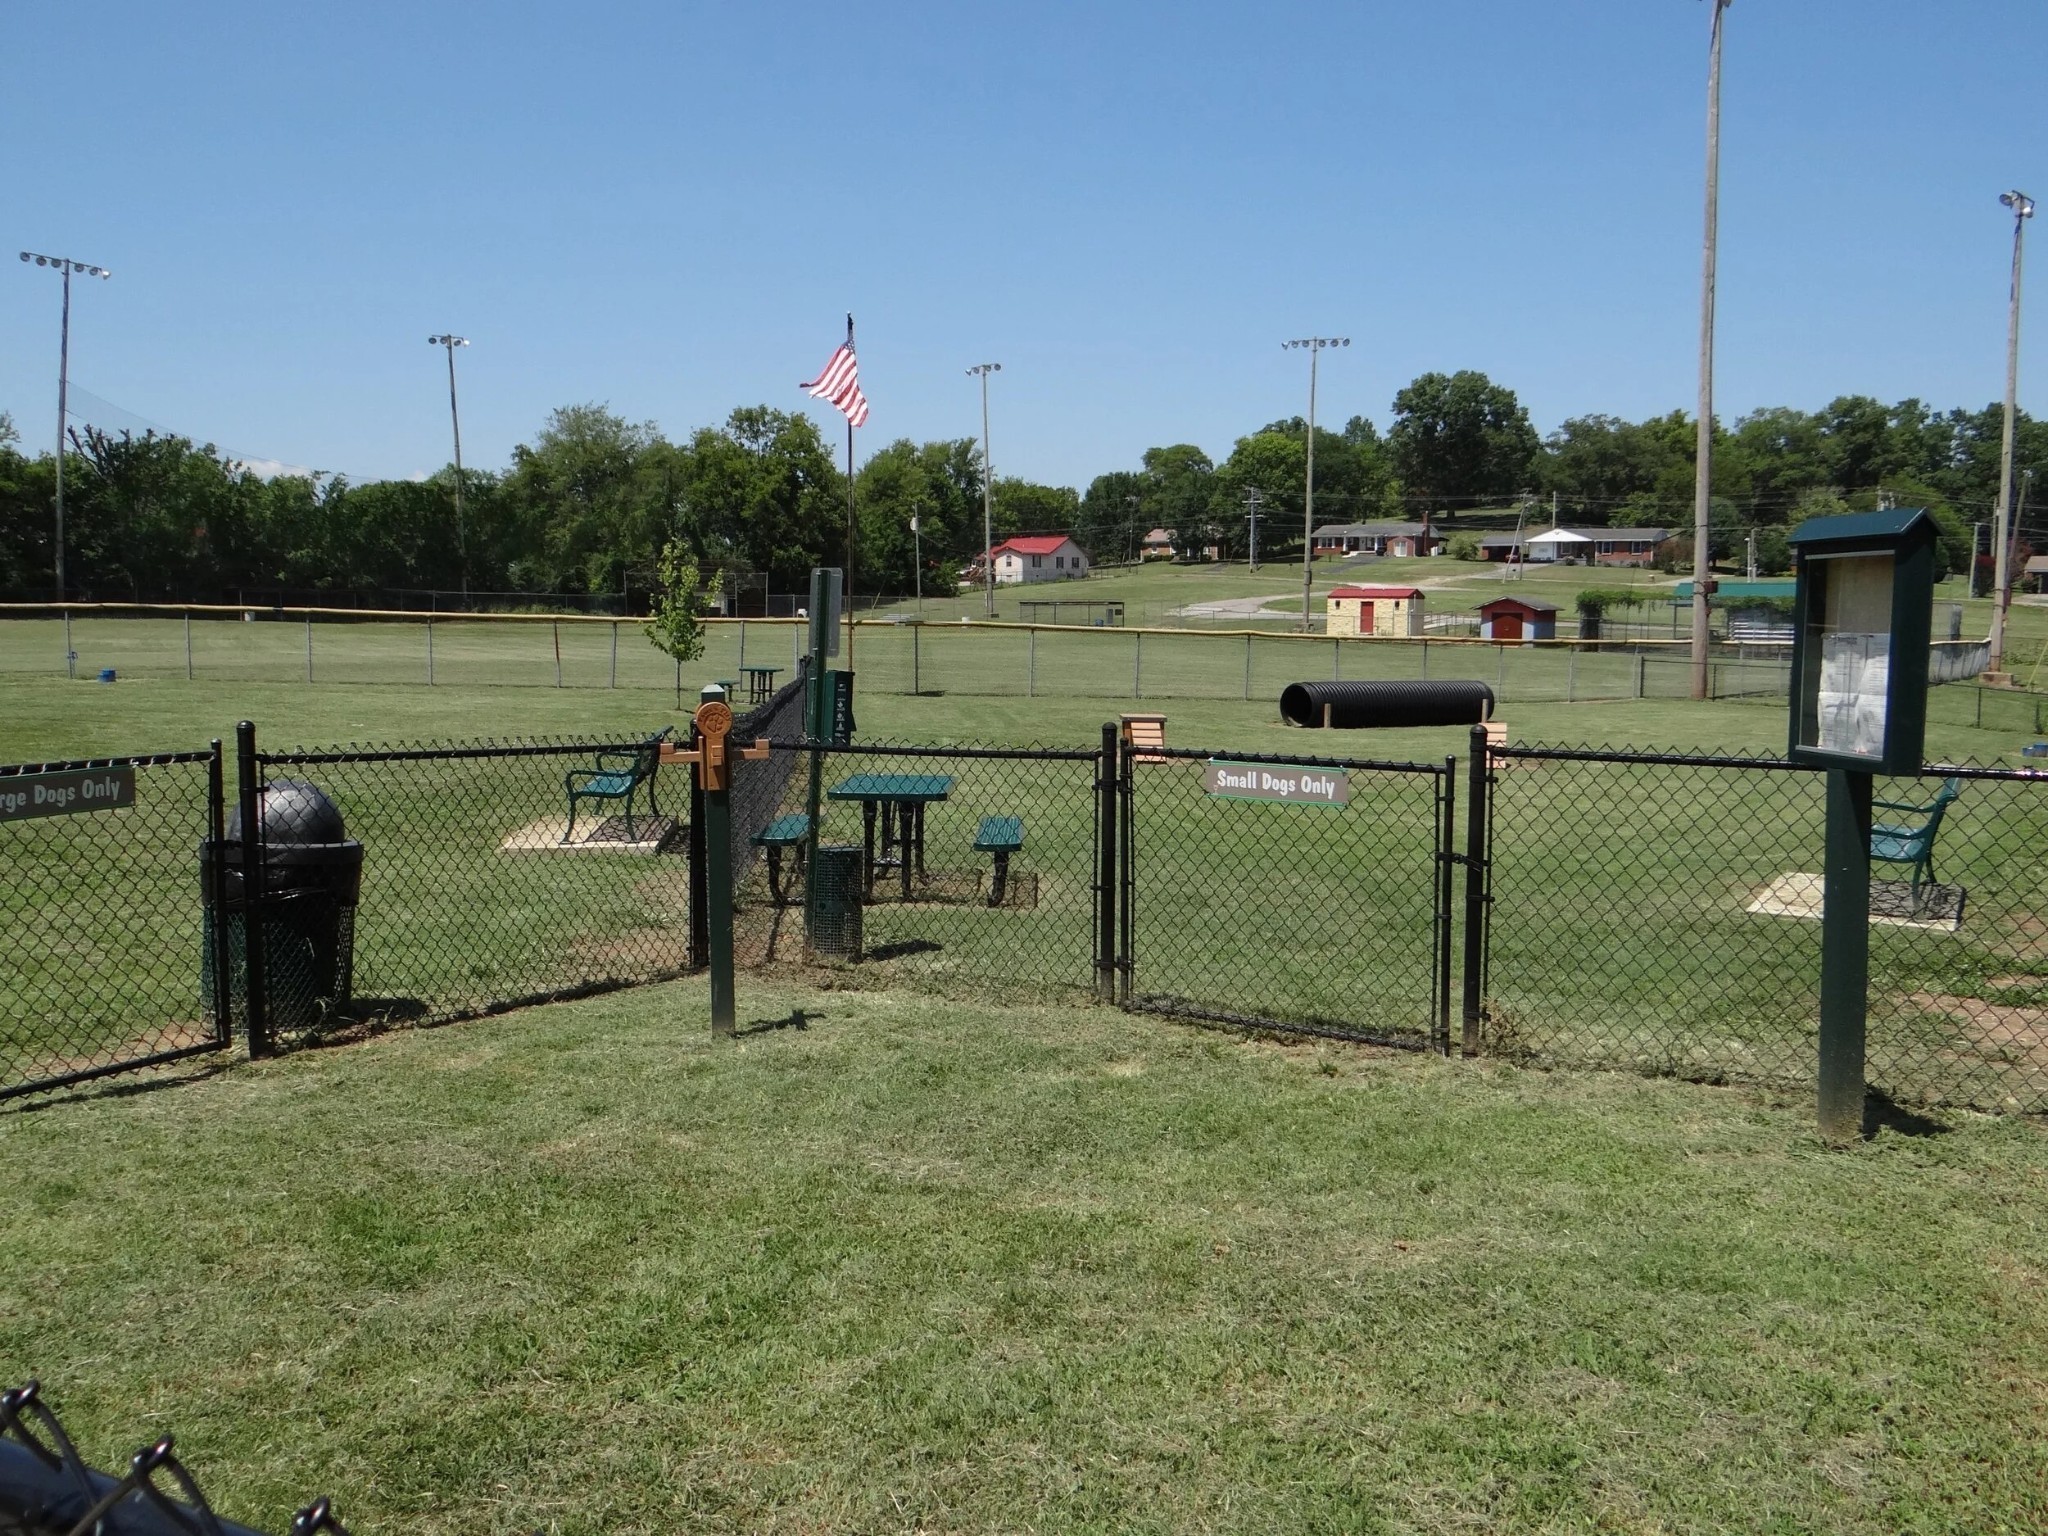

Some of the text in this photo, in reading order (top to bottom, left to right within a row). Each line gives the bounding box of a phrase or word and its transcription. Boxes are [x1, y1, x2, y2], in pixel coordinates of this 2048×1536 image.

[34, 784, 76, 808] Dogs
[82, 776, 120, 801] Only
[1217, 769, 1335, 799] Small Dogs Only
